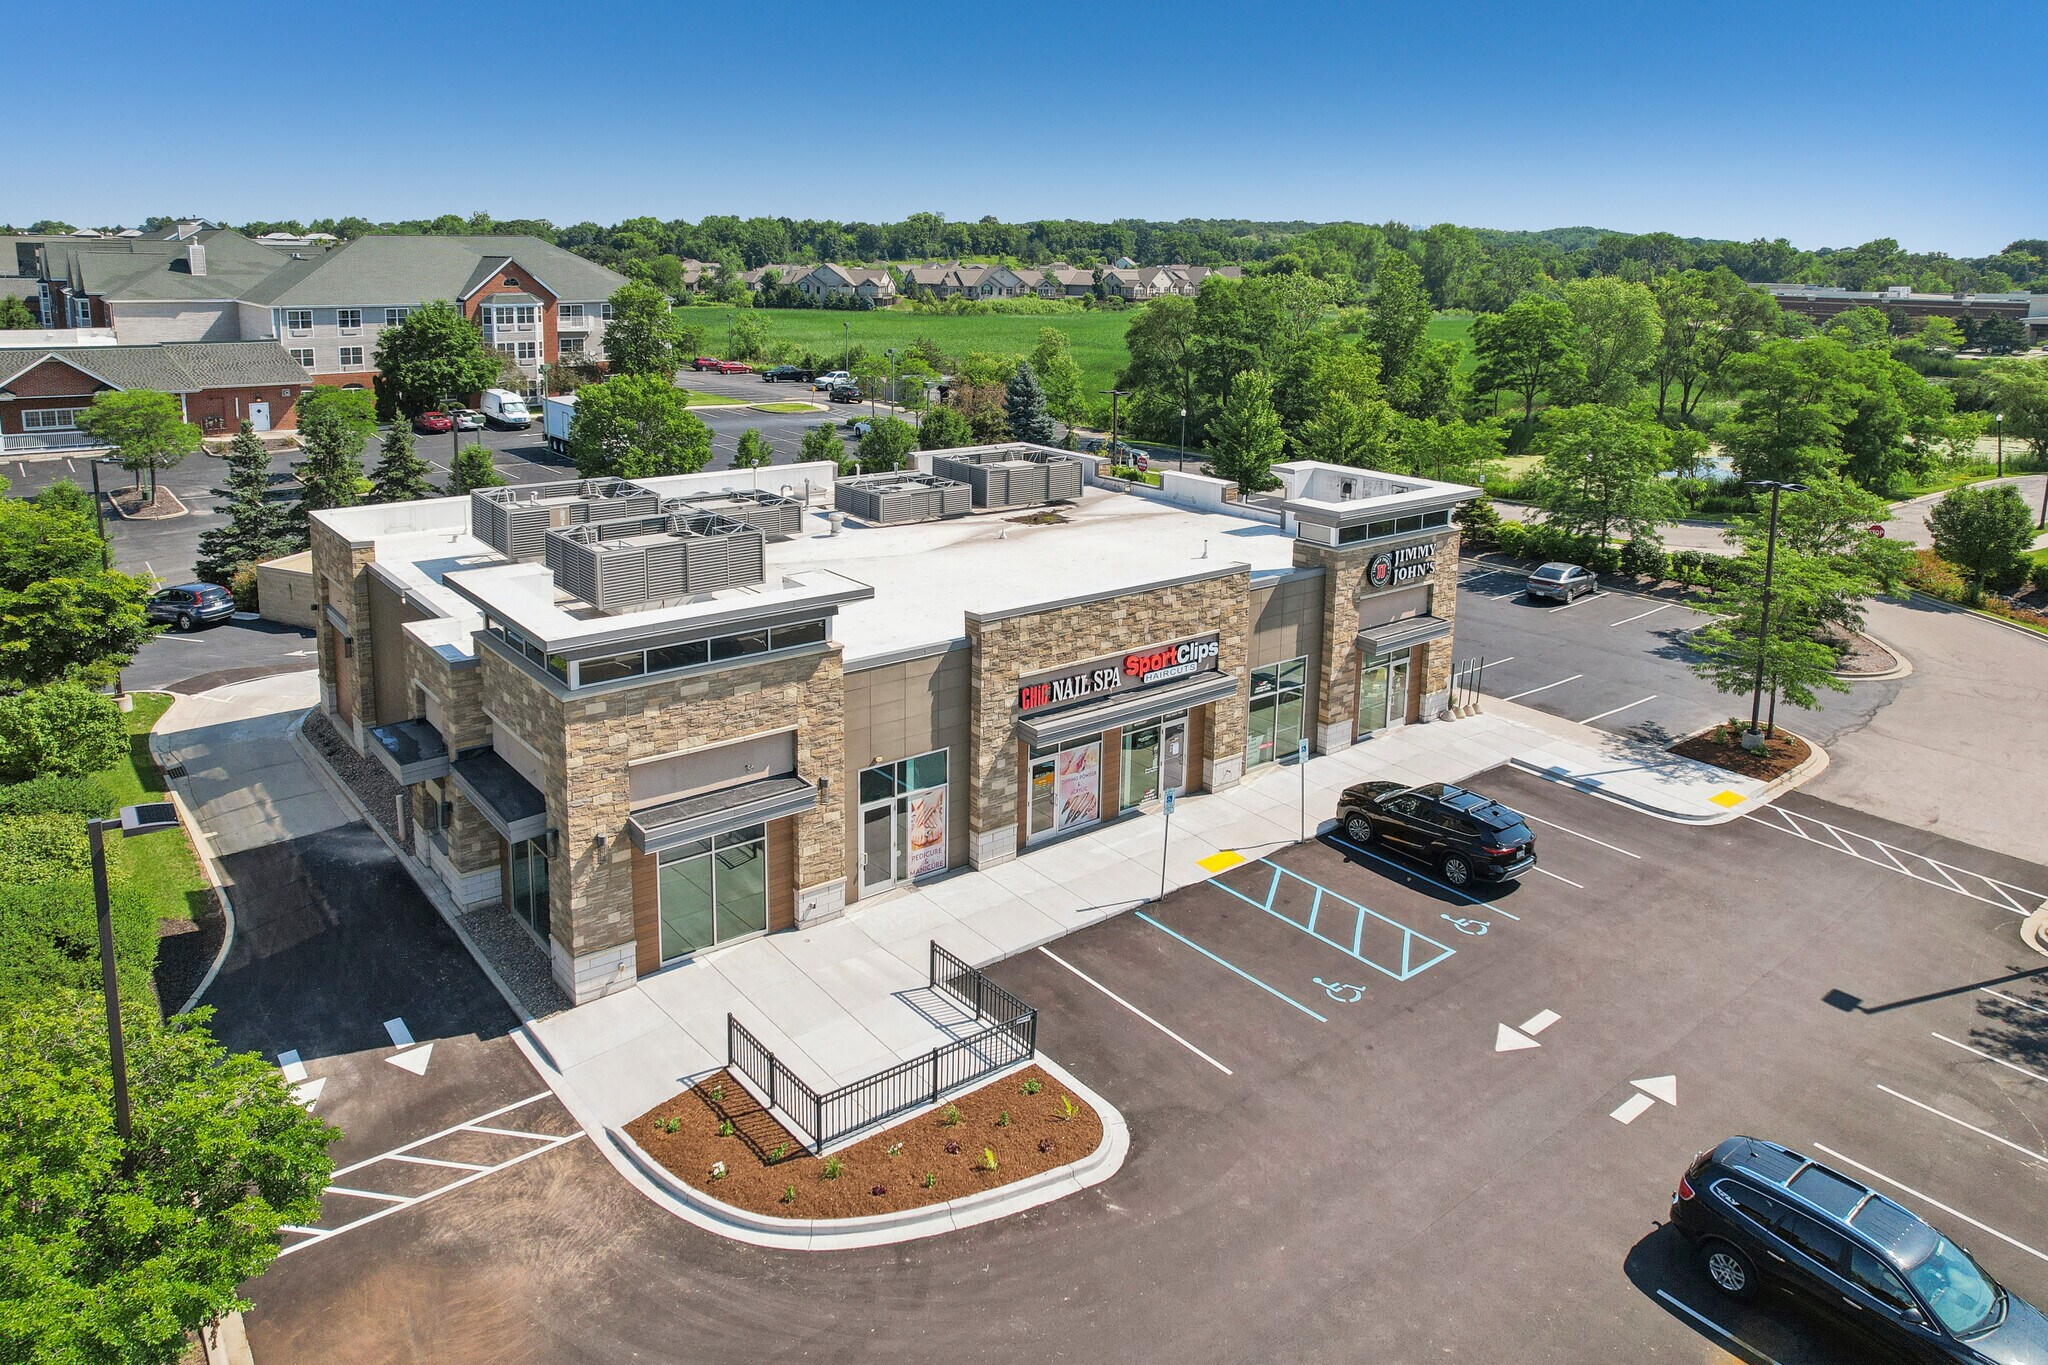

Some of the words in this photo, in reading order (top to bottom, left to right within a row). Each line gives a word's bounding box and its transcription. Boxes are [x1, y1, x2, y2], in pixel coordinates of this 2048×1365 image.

[1394, 543, 1437, 567] JIMMY
[1393, 561, 1436, 586] JOHN'S
[1124, 641, 1219, 677] SportClips
[1145, 663, 1196, 682] HAIRCUTS
[1052, 676, 1091, 703] NAIL
[1093, 666, 1122, 692] SPA
[1062, 776, 1079, 785] DIPPING
[1079, 770, 1097, 780] POWDER
[911, 847, 942, 861] PEDICURE
[909, 860, 944, 875] MANICURE
